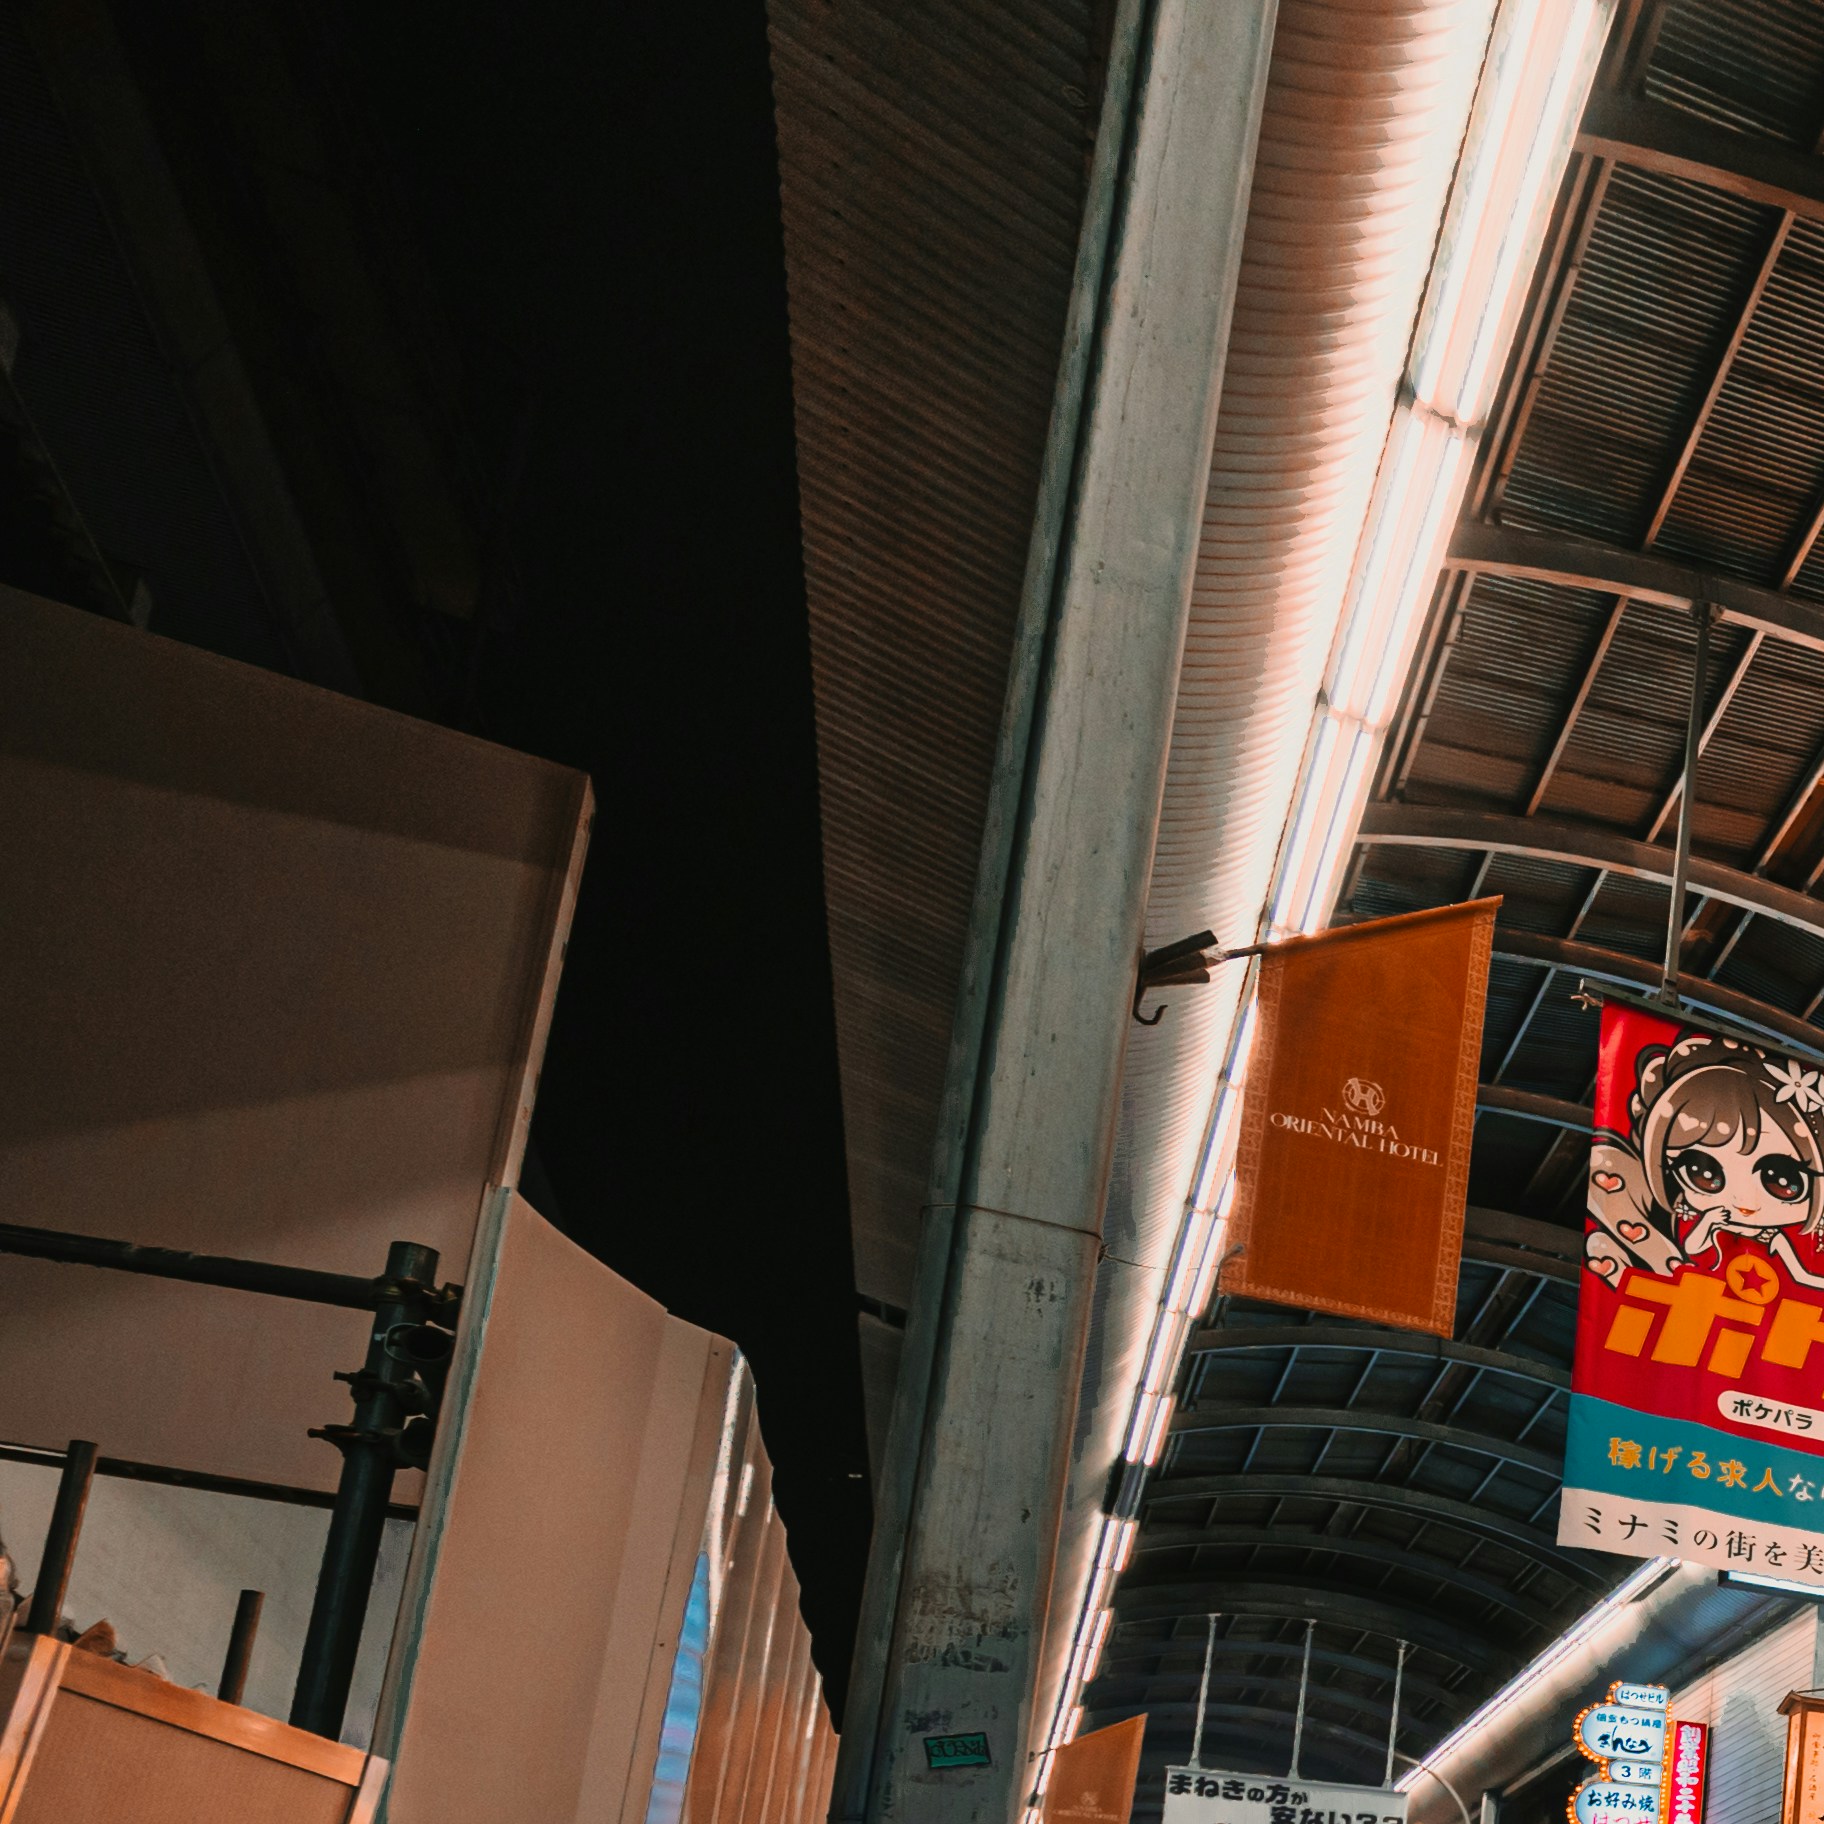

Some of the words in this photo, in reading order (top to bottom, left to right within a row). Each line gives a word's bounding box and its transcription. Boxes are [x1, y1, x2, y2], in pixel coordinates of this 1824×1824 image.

[1270, 1112, 1373, 1151] ORIENTAL
[1379, 1138, 1443, 1168] HOTEL
[1322, 1107, 1400, 1140] NAMBA
[1731, 1398, 1814, 1432] ポケパラ
[1587, 1789, 1655, 1813] お好み焼
